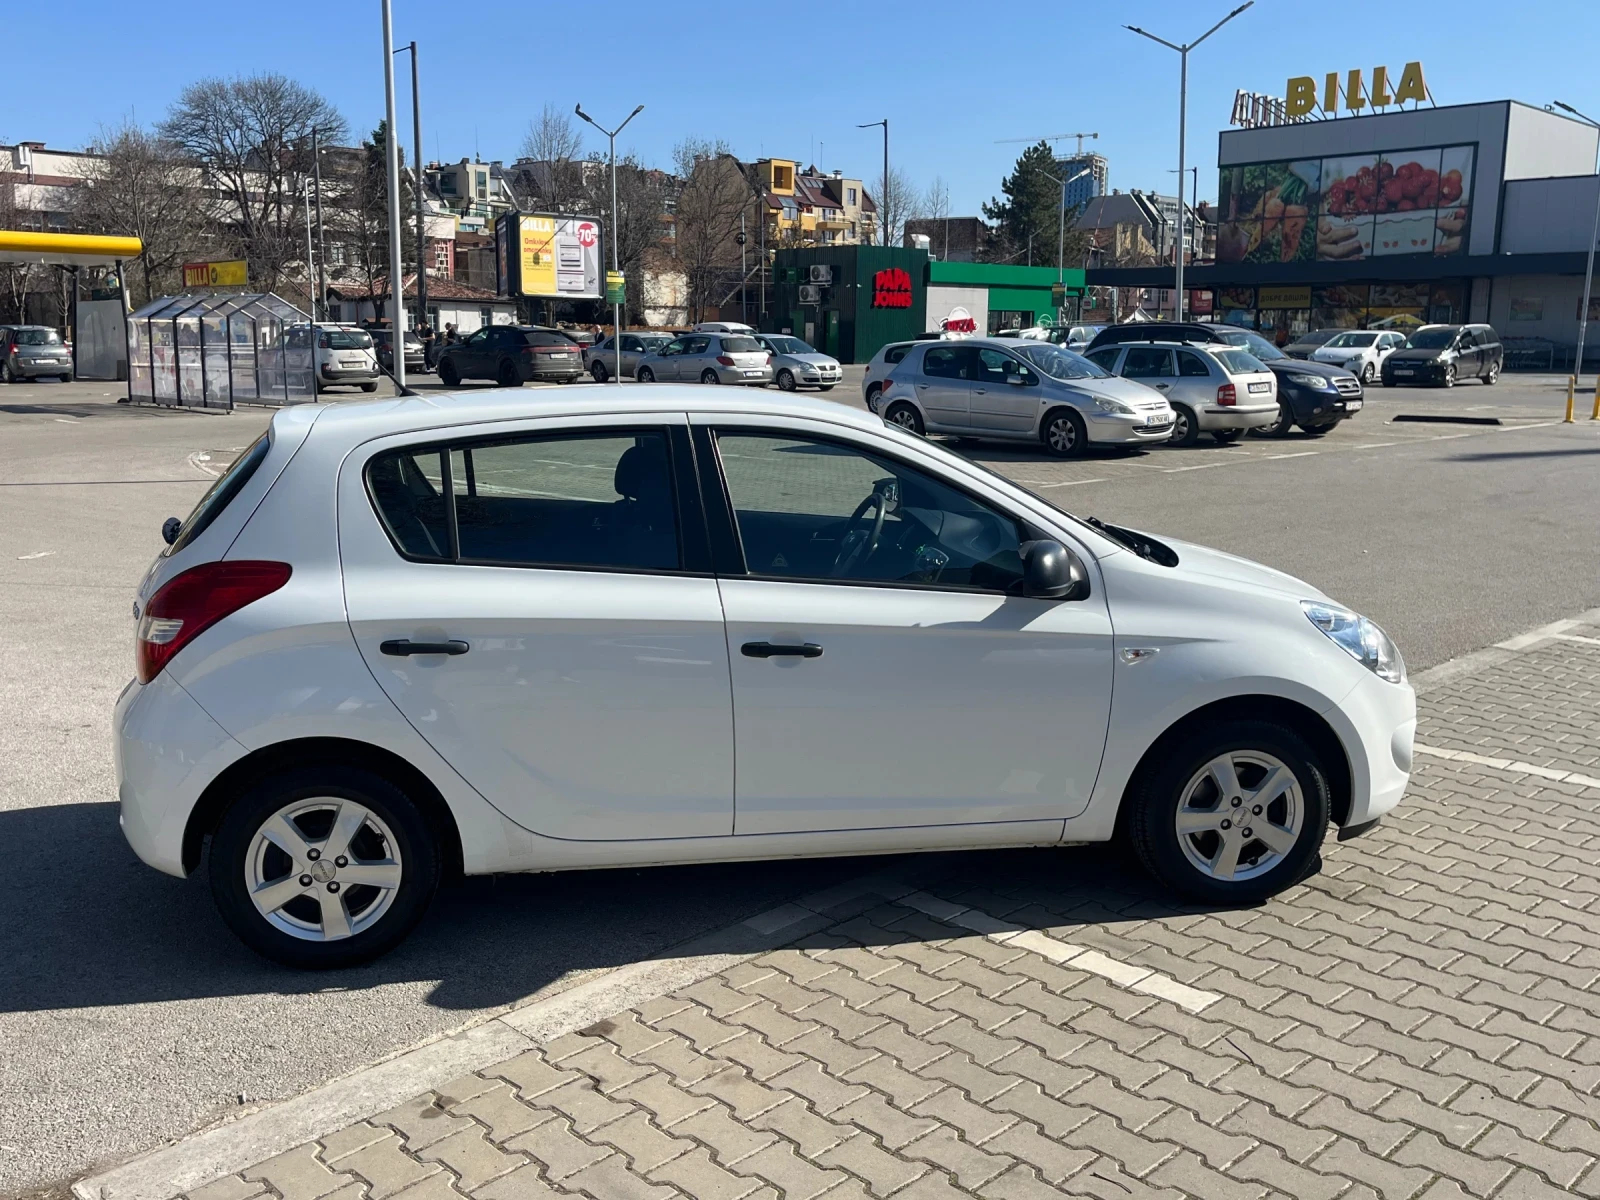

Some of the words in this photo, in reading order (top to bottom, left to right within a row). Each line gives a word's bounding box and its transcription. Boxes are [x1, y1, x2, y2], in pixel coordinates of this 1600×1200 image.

[1285, 61, 1427, 117] BILLA
[521, 219, 551, 232] BILLA
[185, 267, 209, 287] BILLA
[874, 267, 912, 290] PAPA
[873, 290, 913, 307] JOHNS
[1260, 295, 1282, 303] ДОБРЕ
[1283, 294, 1309, 302] ДОШЛИ
